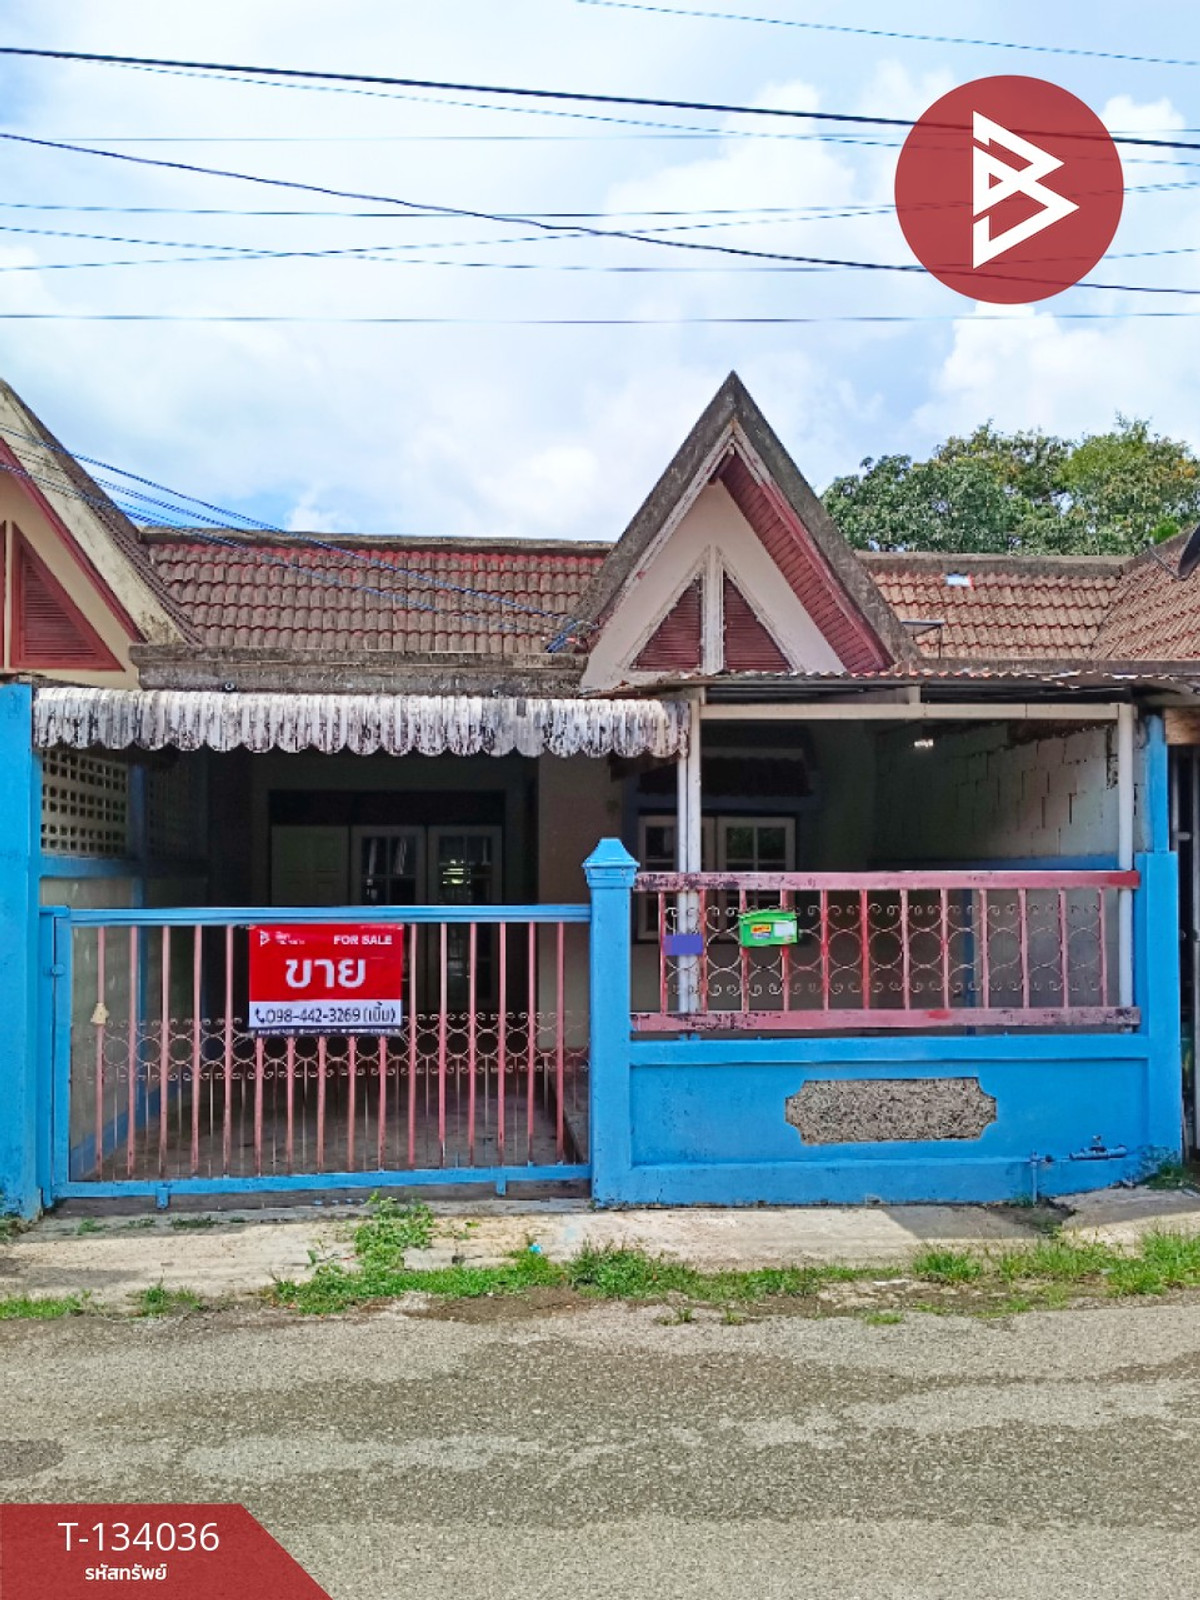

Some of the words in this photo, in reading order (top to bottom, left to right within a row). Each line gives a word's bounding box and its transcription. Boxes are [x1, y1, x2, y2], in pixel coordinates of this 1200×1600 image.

[333, 934, 359, 946] FOR
[361, 934, 393, 946] SALE
[285, 958, 367, 989] ขาย
[266, 1006, 361, 1023] 098-442-3269
